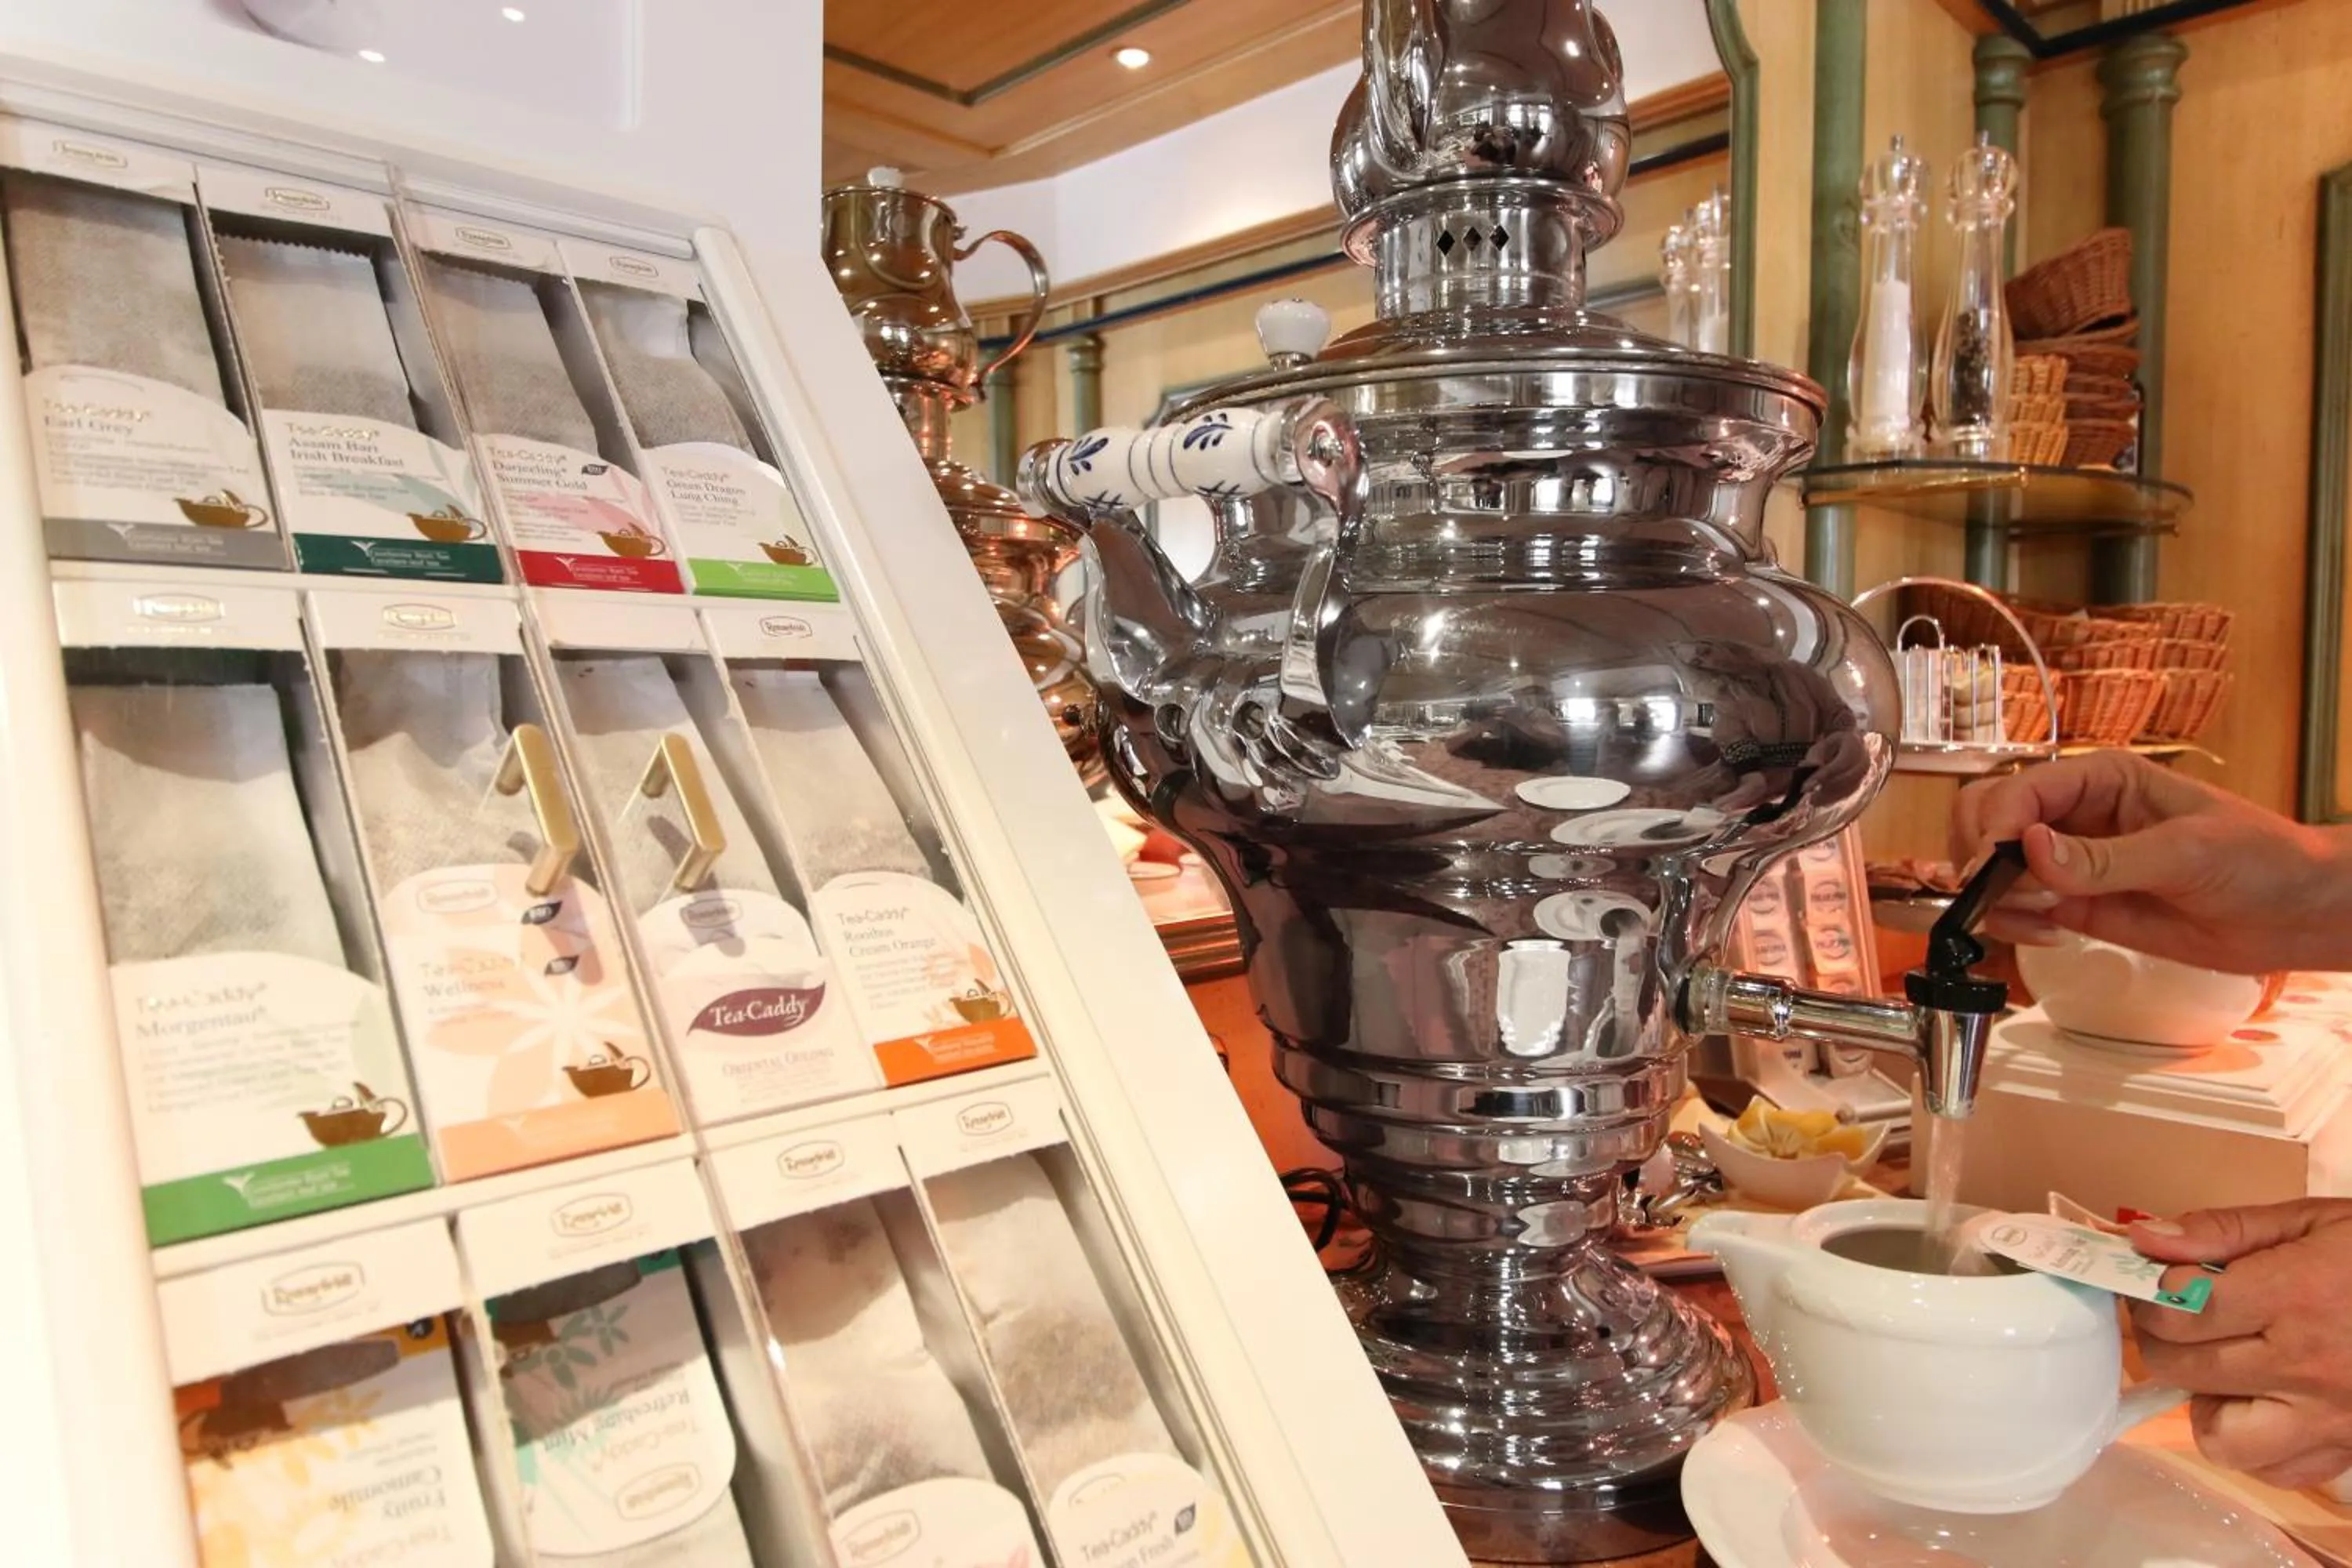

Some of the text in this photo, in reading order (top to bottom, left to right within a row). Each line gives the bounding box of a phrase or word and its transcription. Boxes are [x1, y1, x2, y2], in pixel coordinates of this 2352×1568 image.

[289, 437, 342, 452] Assam
[290, 449, 405, 468] Irish Breakfast
[495, 472, 588, 491] Summer Gold
[666, 479, 746, 496] Green Dragon
[849, 938, 936, 958] Cream Orange
